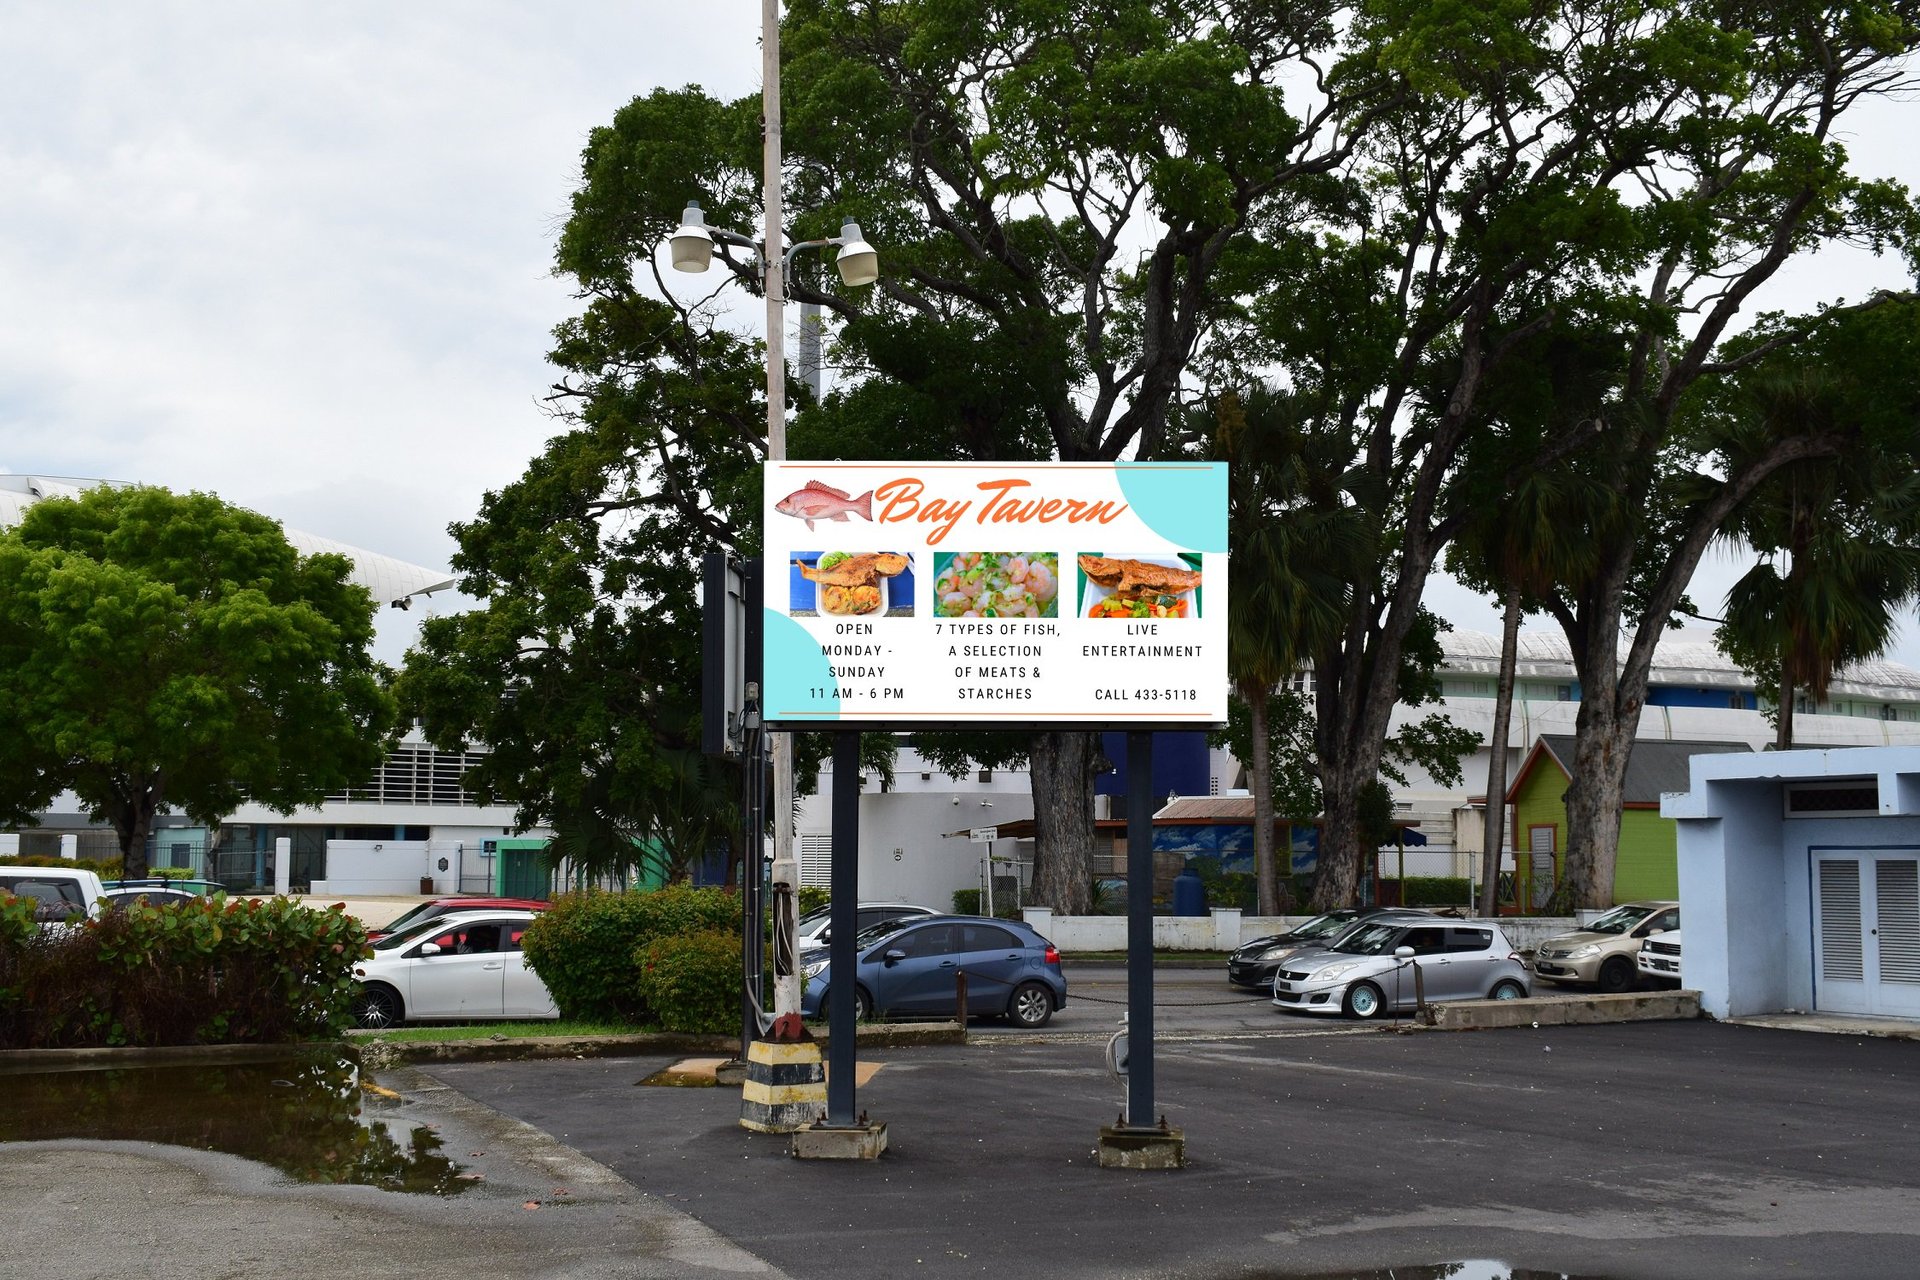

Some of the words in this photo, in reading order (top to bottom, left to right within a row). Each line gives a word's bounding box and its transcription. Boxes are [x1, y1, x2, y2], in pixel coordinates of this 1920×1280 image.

[875, 478, 972, 546] Bay
[977, 479, 1128, 524] Tavern
[836, 624, 873, 635] OPEN
[935, 624, 943, 634] 7
[949, 624, 993, 635] TYPES
[1000, 624, 1016, 635] OF
[1024, 624, 1060, 637] FISH,
[1127, 625, 1158, 635] LIVE
[822, 645, 882, 656] MONDAY
[948, 645, 957, 656] A
[963, 645, 1042, 656] SELECTION
[1082, 646, 1203, 657] ENTERTAINMENT
[828, 667, 885, 678] SUNDAY
[955, 667, 972, 677] OF
[979, 667, 1026, 677] MEATS
[1032, 667, 1041, 678] &
[810, 688, 825, 698] 11
[833, 688, 852, 698] AM
[870, 688, 877, 698] 6
[884, 688, 904, 699] PM
[958, 688, 1032, 699] STARCHES
[1095, 689, 1129, 700] CALL
[1134, 689, 1197, 700] 433-5118
